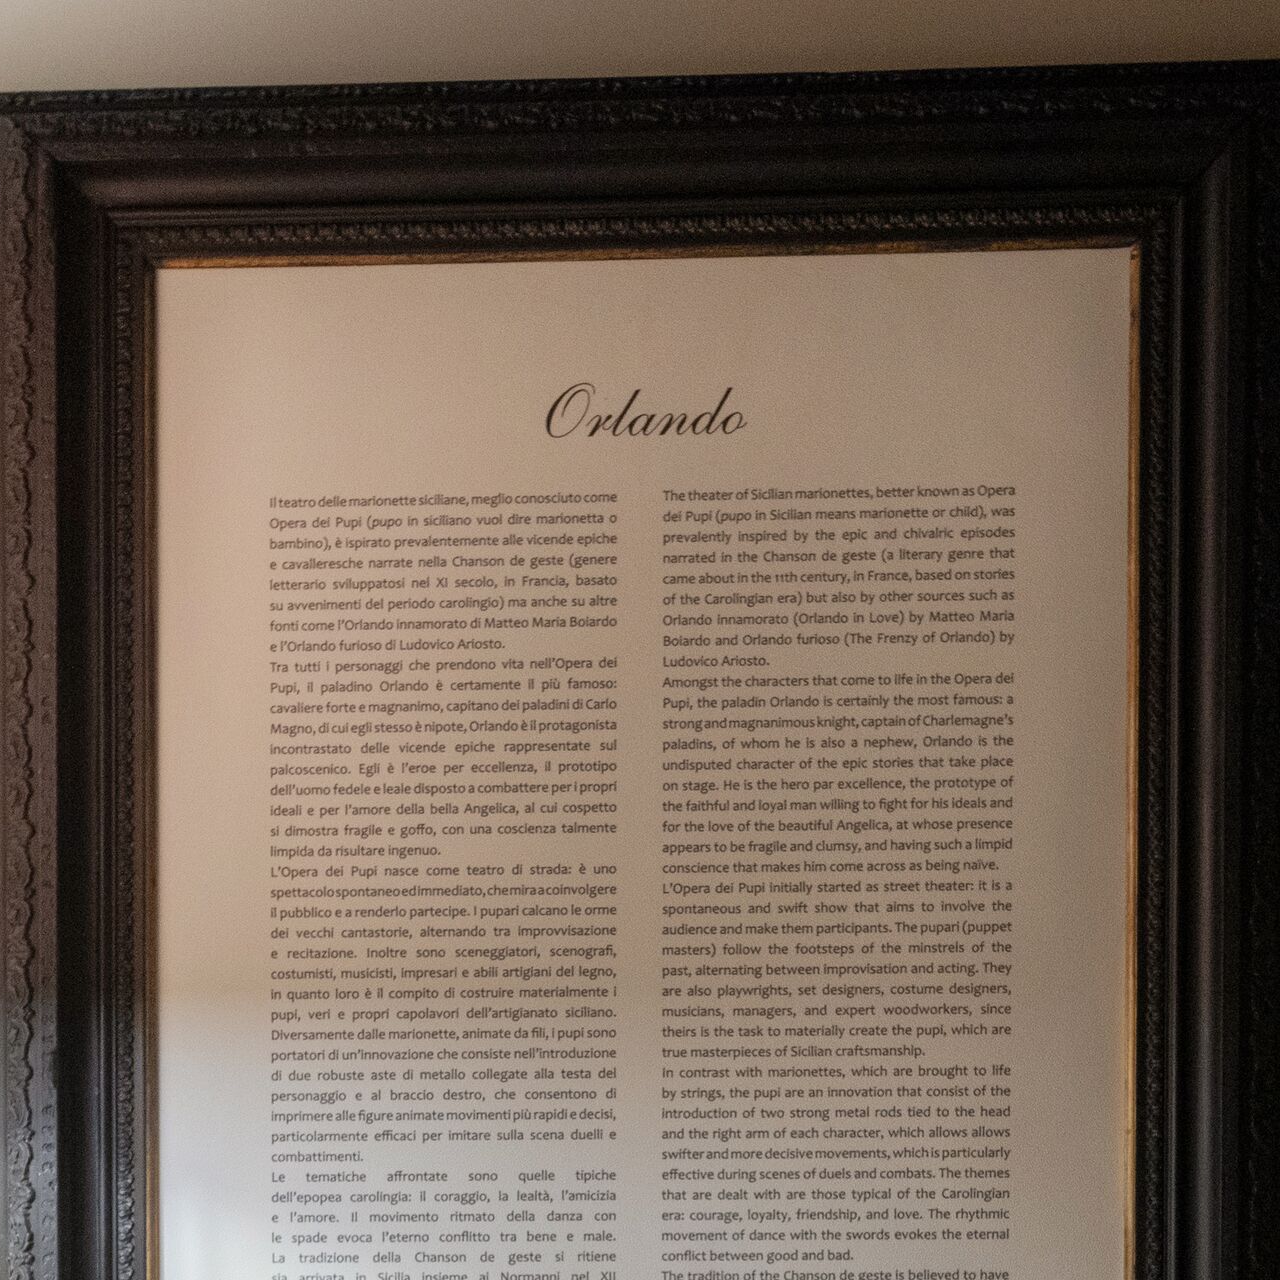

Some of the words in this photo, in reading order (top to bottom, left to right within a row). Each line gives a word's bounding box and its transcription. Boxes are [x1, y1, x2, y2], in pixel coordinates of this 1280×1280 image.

[546, 382, 748, 438] Orlando
[269, 515, 306, 531] Opera
[311, 515, 330, 527] dei
[335, 515, 362, 530] Pupi
[366, 514, 402, 529] (pupo
[407, 515, 418, 526] in
[423, 513, 472, 526] siciliano
[476, 513, 502, 525] vuol
[507, 513, 531, 525] dire
[535, 512, 604, 524] marionetta
[608, 514, 617, 523] o
[662, 529, 732, 545] prevalently
[737, 528, 787, 544] inspired
[792, 528, 808, 543] by
[814, 528, 835, 540] the
[841, 528, 867, 543] epic
[873, 527, 898, 539] and
[902, 526, 954, 539] chivalric
[960, 526, 1015, 541] episodes
[269, 577, 326, 590] letterario
[332, 576, 405, 592] sviluppatosi
[411, 576, 430, 588] nel
[436, 576, 448, 588] XI
[454, 575, 498, 589] secolo,
[504, 575, 515, 587] in
[521, 574, 569, 589] Francia,
[575, 574, 618, 586] basato
[269, 742, 351, 754] incontrastato
[360, 741, 389, 753] delle
[398, 741, 445, 753] vicende
[454, 740, 495, 755] epiche
[503, 741, 590, 755] rappresentate
[599, 739, 617, 751] sul
[662, 758, 732, 773] undisputed
[736, 757, 795, 769] character
[798, 757, 812, 769] of
[816, 757, 838, 769] the
[842, 757, 867, 771] epic
[872, 756, 914, 768] stories
[918, 755, 944, 768] that
[948, 755, 976, 767] take
[980, 755, 1013, 770] place
[662, 903, 741, 917] spontaneous
[747, 901, 771, 913] and
[777, 901, 808, 913] swift
[814, 900, 848, 913] show
[853, 900, 879, 912] that
[886, 901, 914, 912] aims
[920, 901, 934, 912] to
[940, 899, 985, 912] involve
[991, 899, 1012, 911] the
[270, 926, 288, 938] dei
[296, 926, 334, 938] vecchi
[340, 926, 412, 940] cantastorie,
[419, 925, 486, 937] alternando
[493, 926, 510, 936] tra
[517, 924, 617, 939] improvvisazione
[661, 1005, 724, 1019] musicians,
[732, 1007, 796, 1019] managers,
[804, 1004, 827, 1016] and
[834, 1005, 875, 1018] expert
[883, 1003, 972, 1017] woodworkers,
[980, 1003, 1011, 1014] since
[271, 1170, 285, 1182] Le
[305, 1170, 366, 1182] tematiche
[386, 1169, 447, 1181] affrontate
[468, 1172, 498, 1181] sono
[518, 1169, 555, 1184] quelle
[575, 1168, 616, 1183] tipiche
[661, 1211, 684, 1220] era:
[689, 1211, 742, 1223] courage,
[747, 1208, 791, 1223] loyalty,
[796, 1207, 860, 1223] friendship,
[865, 1207, 889, 1219] and
[893, 1207, 922, 1219] love.
[928, 1207, 950, 1219] The
[955, 1207, 1009, 1222] rhythmic
